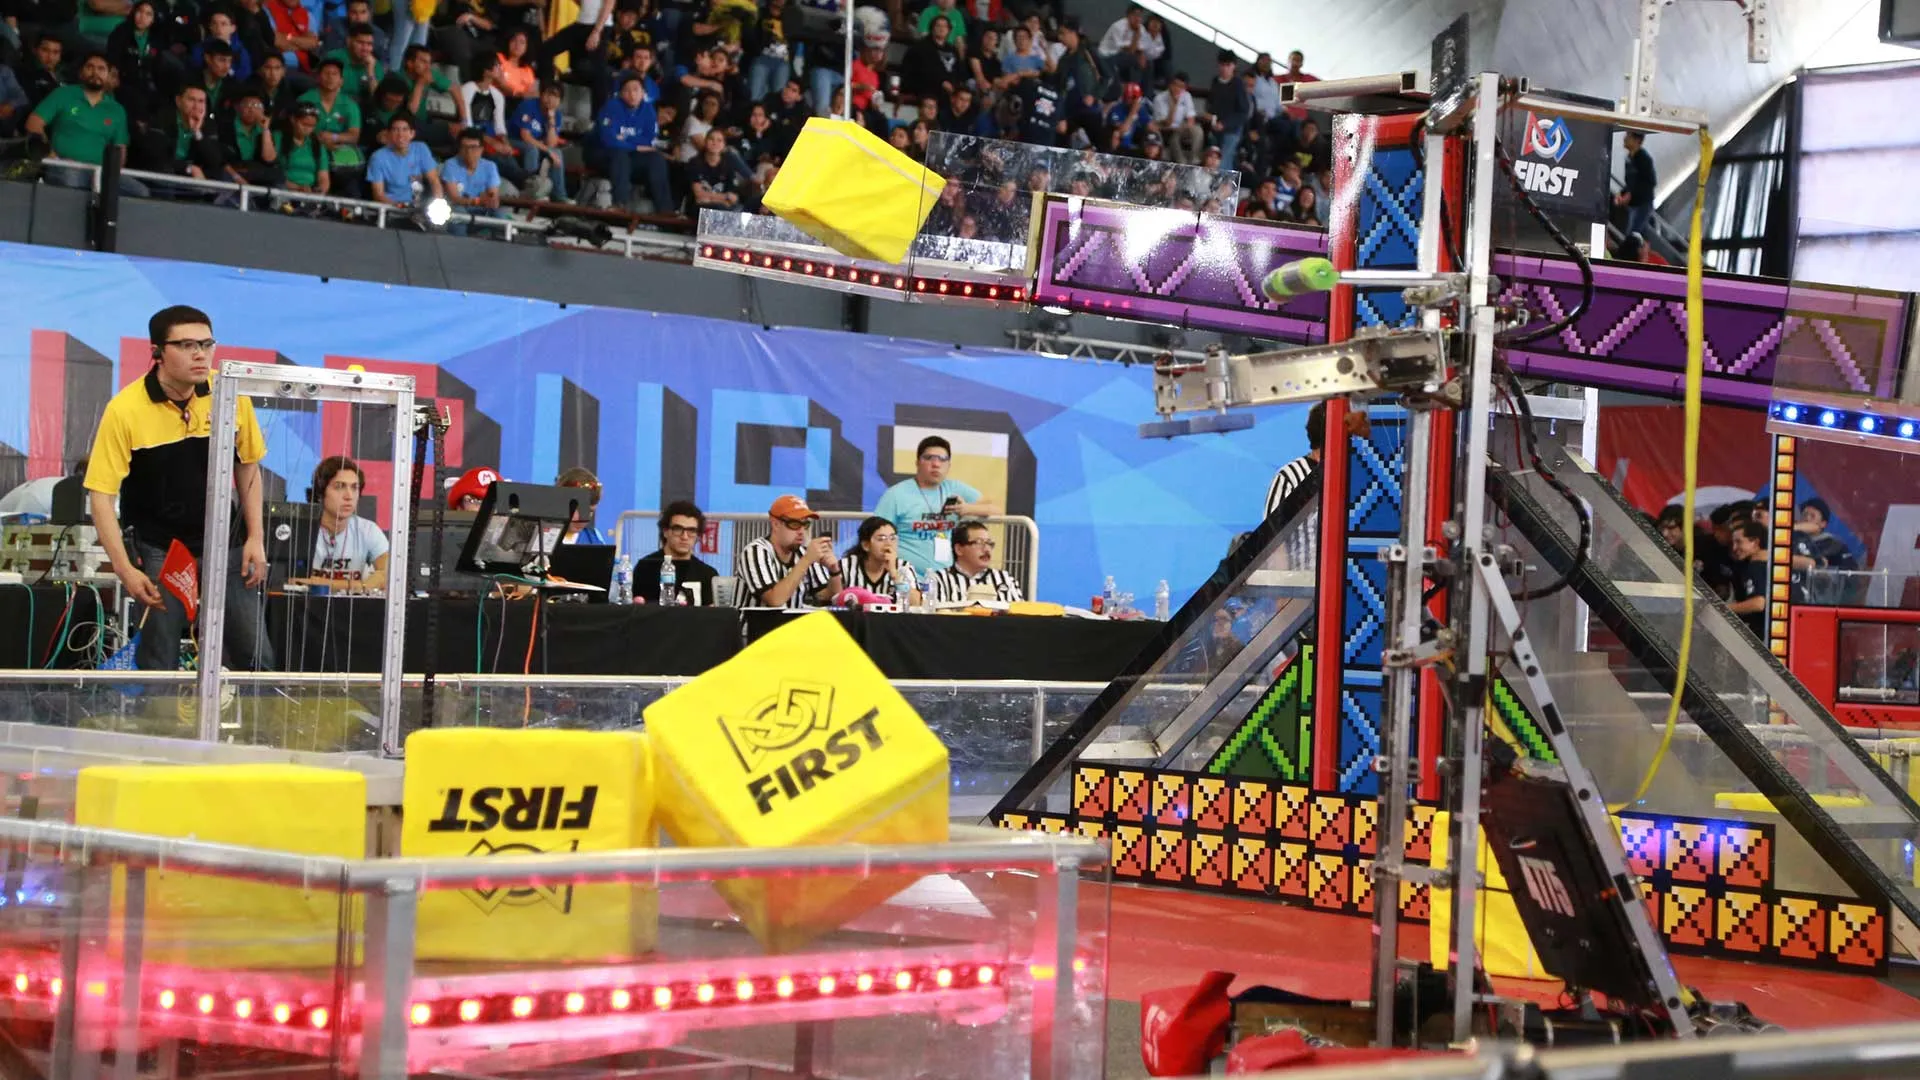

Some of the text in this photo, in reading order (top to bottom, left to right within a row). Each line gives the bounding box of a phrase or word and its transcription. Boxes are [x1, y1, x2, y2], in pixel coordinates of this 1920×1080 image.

[1514, 159, 1579, 197] FIRST
[747, 706, 884, 816] FIRST
[428, 785, 598, 833] FIRST
